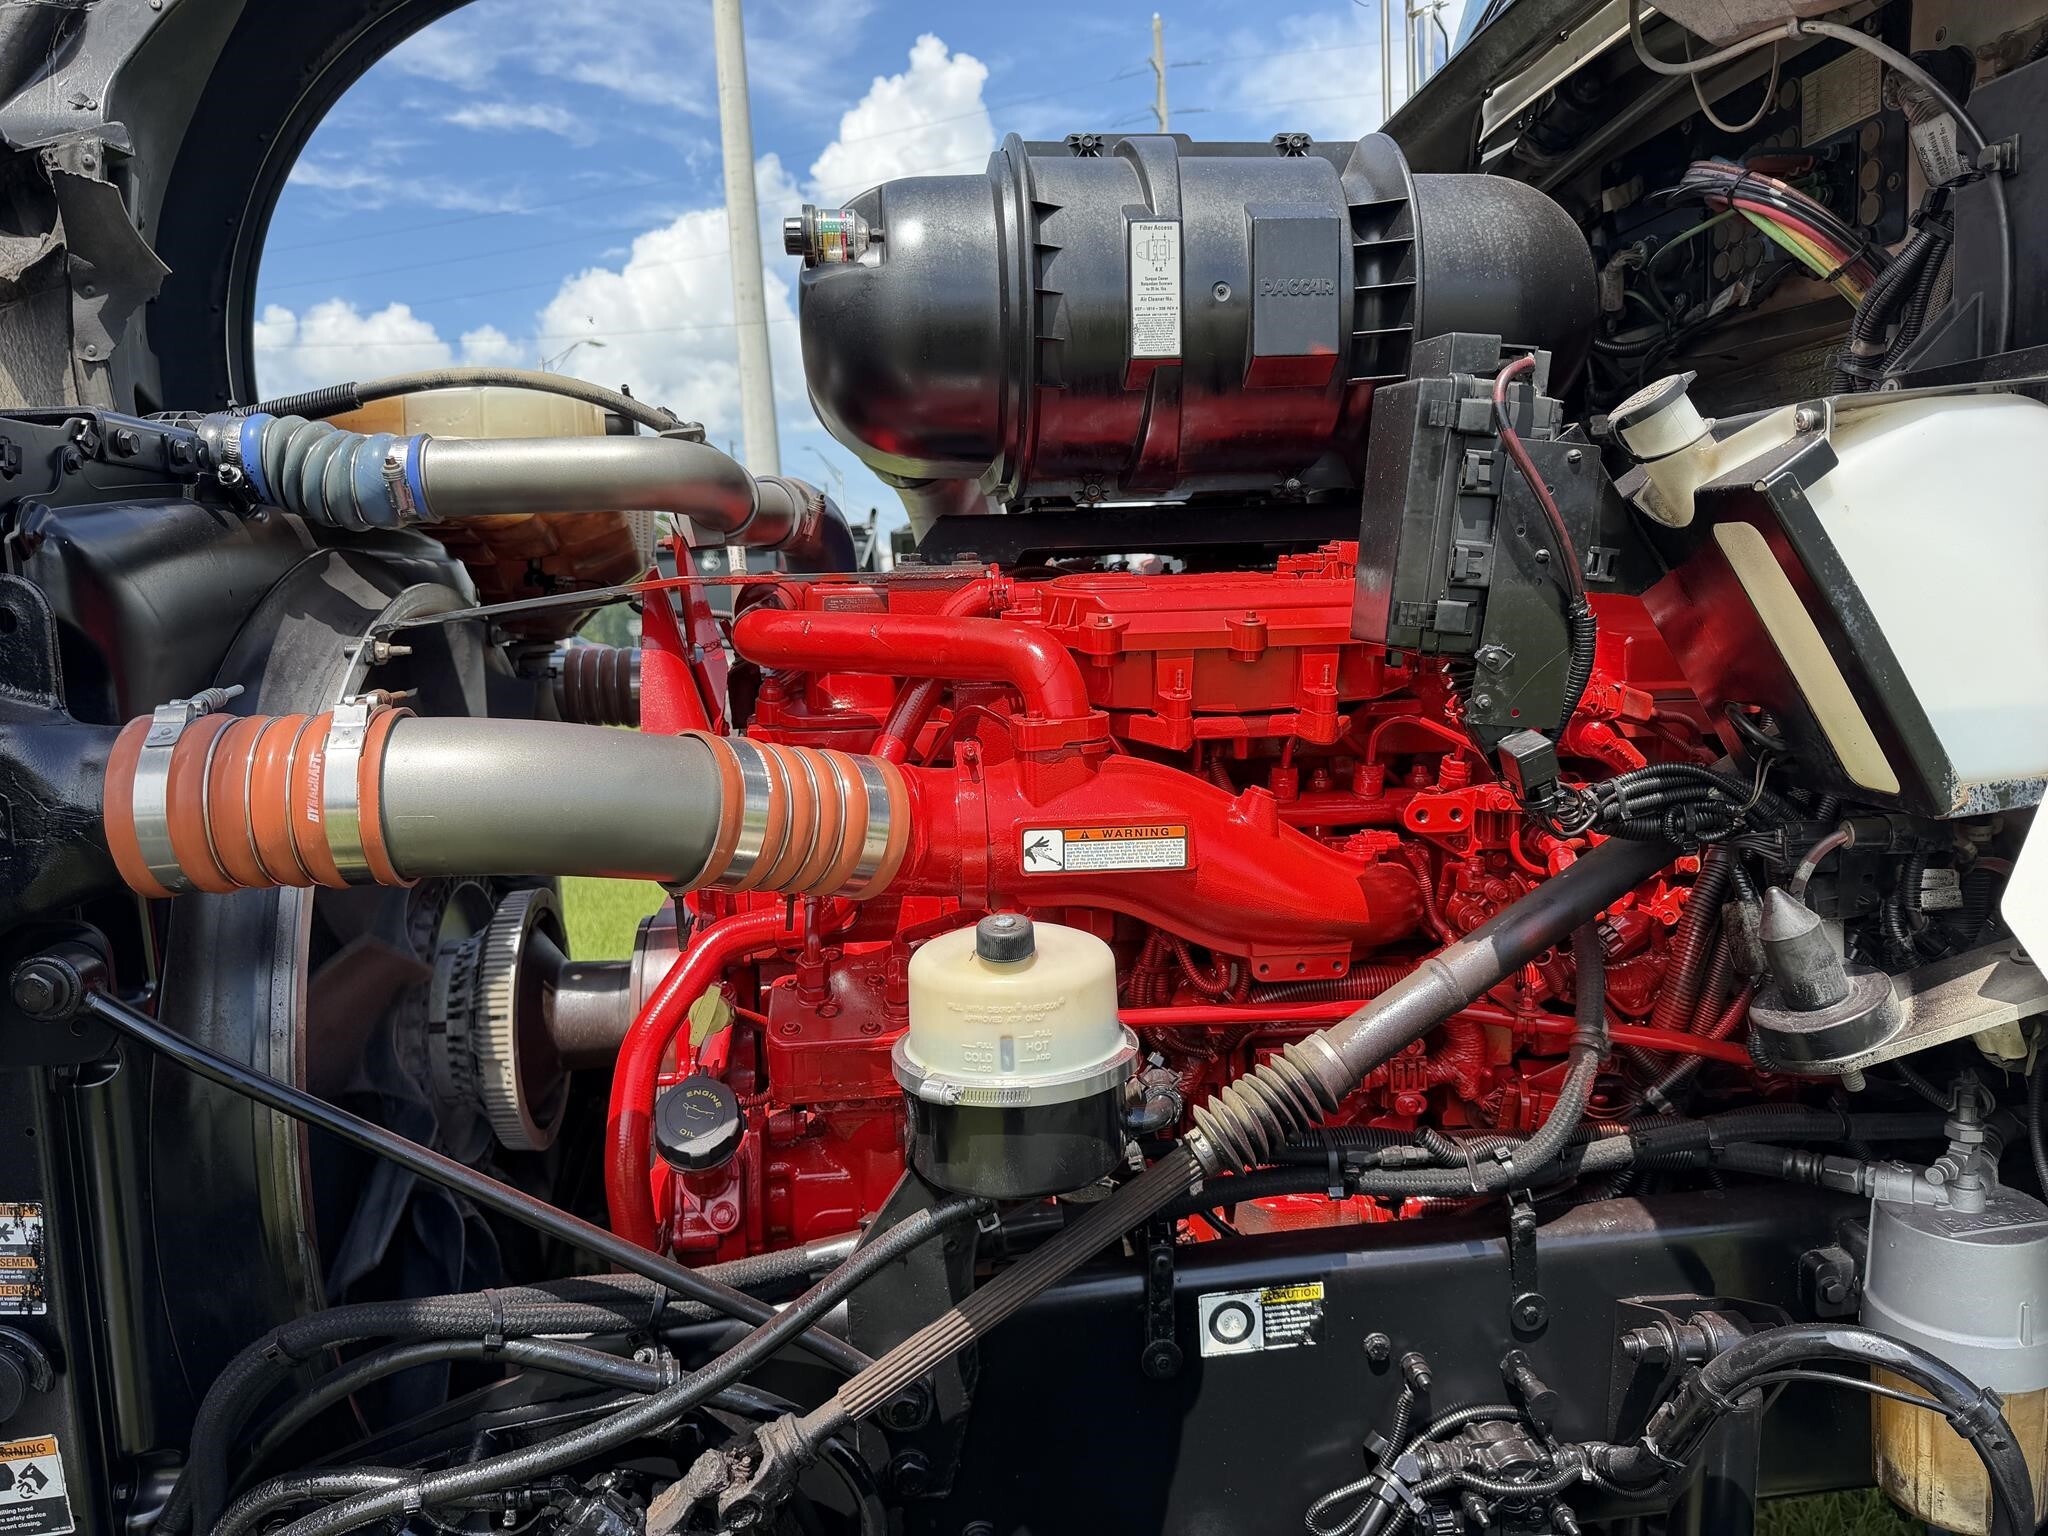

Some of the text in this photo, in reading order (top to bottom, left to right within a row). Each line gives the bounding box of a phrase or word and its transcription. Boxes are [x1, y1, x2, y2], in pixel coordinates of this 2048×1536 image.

[1260, 279, 1334, 296] PACCAR
[1101, 827, 1169, 838] WARNING
[1025, 1040, 1049, 1052] HOT
[964, 1051, 993, 1063] COLD
[1035, 1053, 1052, 1061] ADD
[977, 1065, 993, 1073] ADD
[686, 1089, 723, 1109] ENGINE
[680, 1128, 696, 1138] OIL
[1273, 1288, 1319, 1299] CAUTION
[18, 1520, 42, 1529] closing.
